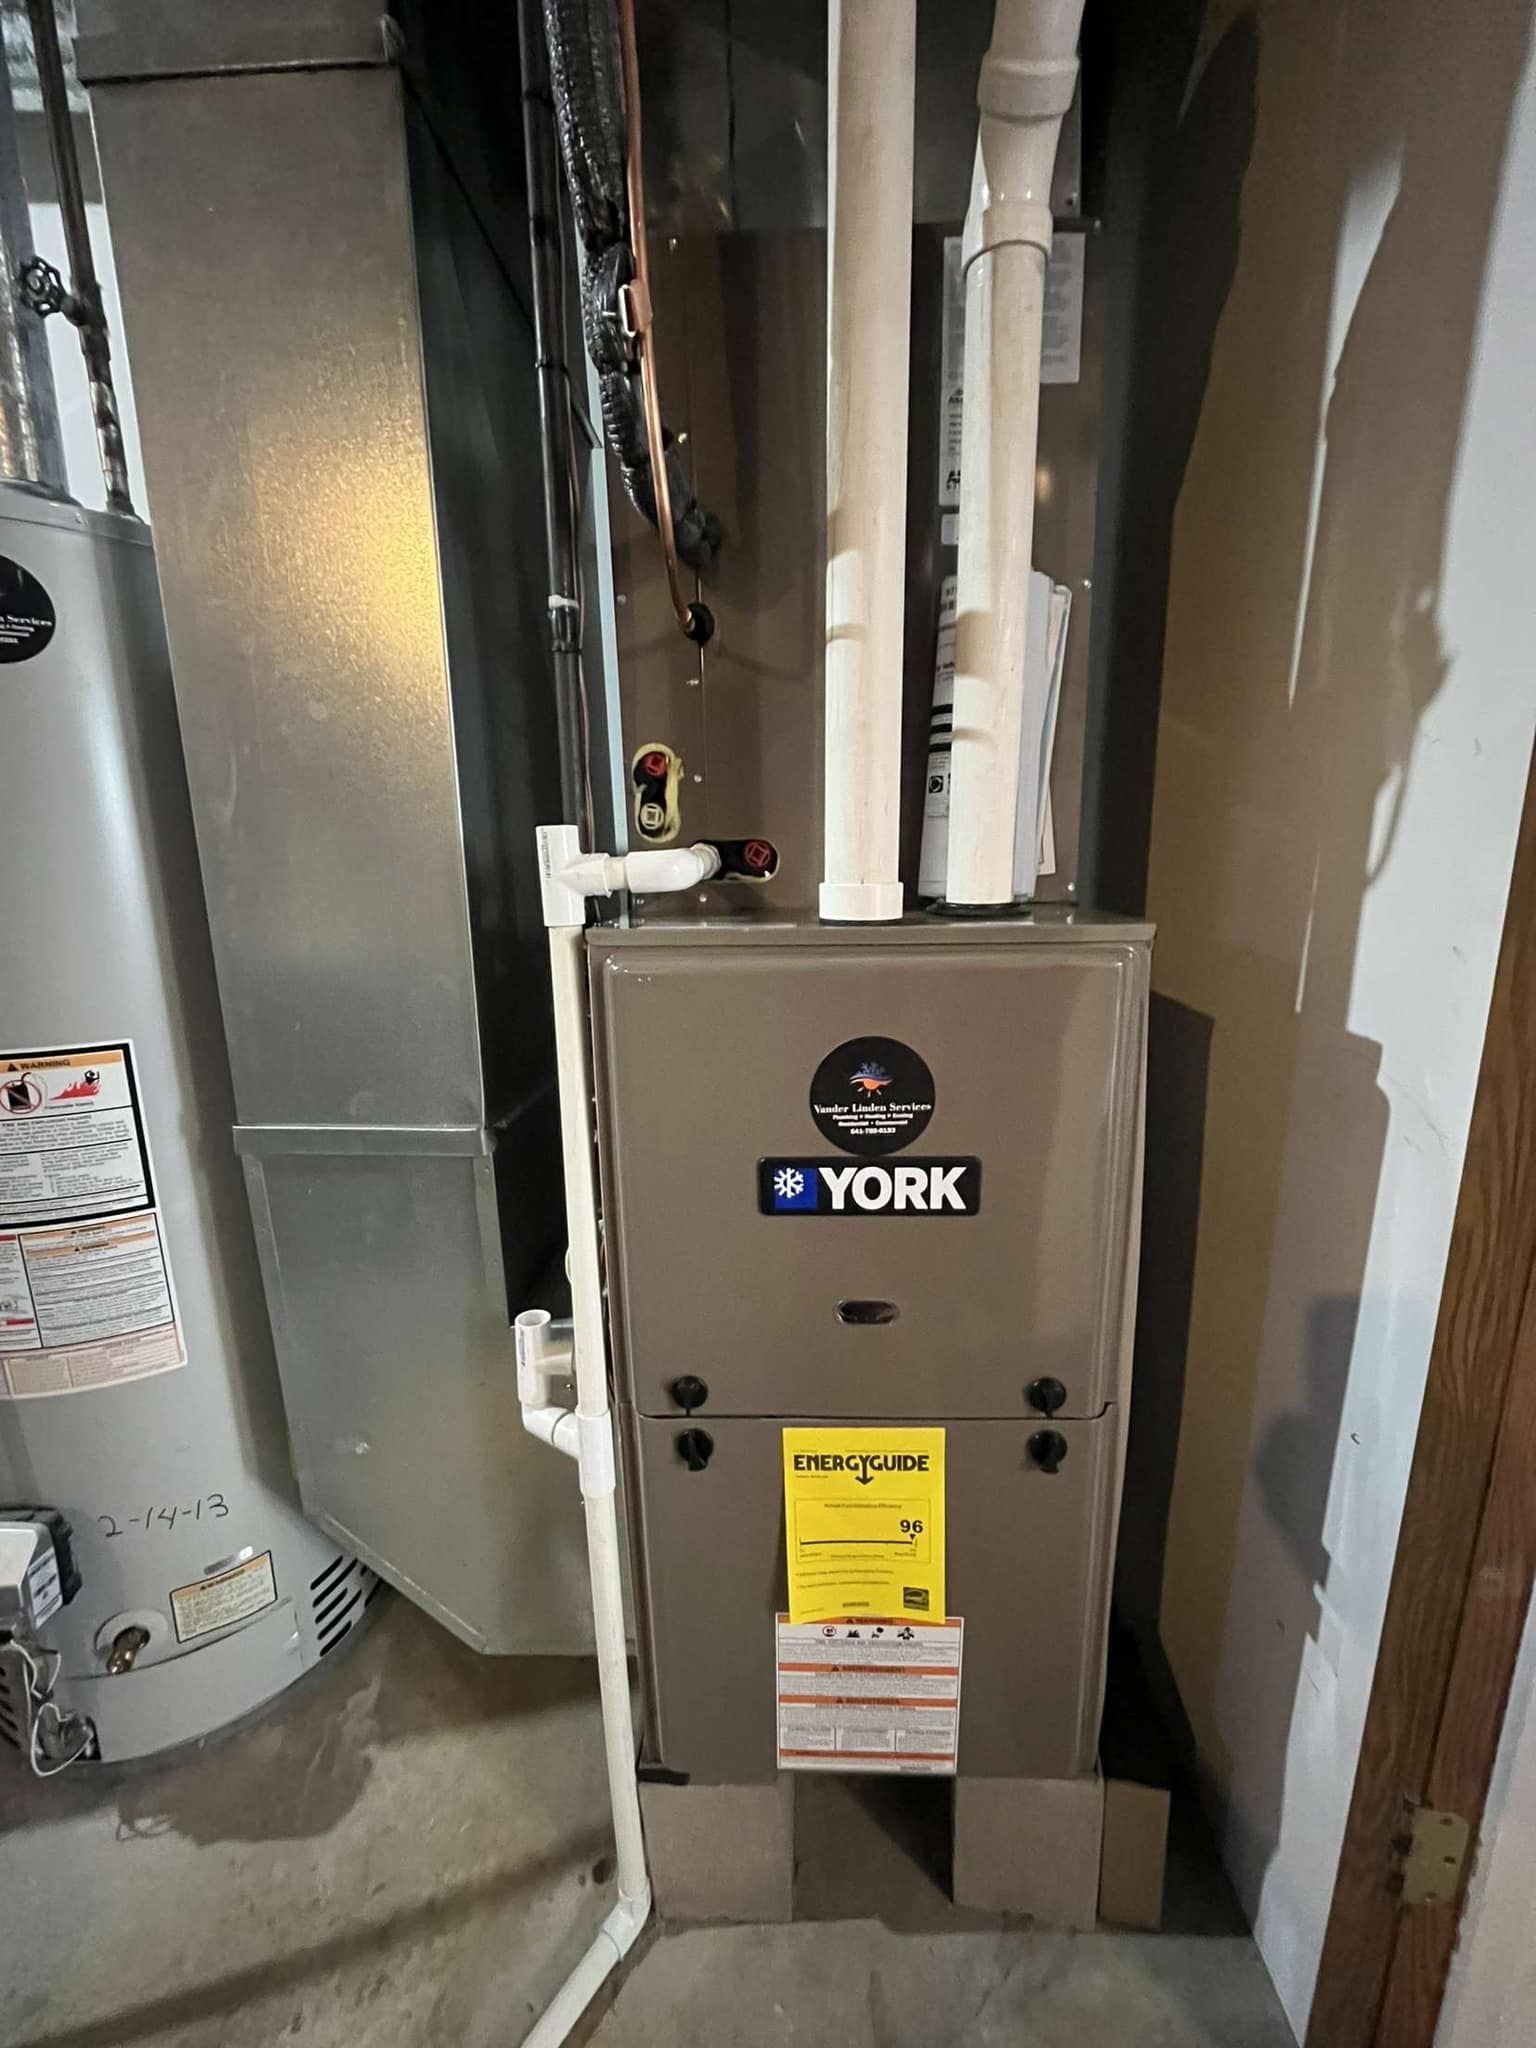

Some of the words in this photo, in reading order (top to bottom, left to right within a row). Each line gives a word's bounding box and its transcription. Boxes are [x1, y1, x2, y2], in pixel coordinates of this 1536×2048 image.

[21, 1059, 71, 1070] WARNING
[814, 1104, 849, 1114] Vander
[852, 1103, 887, 1113] Linden
[889, 1102, 932, 1112] Services
[818, 1166, 967, 1210] YORK
[793, 1454, 930, 1473] ENERGYGUIDE
[97, 1493, 229, 1538] 2-14-13
[900, 1519, 923, 1533] 96
